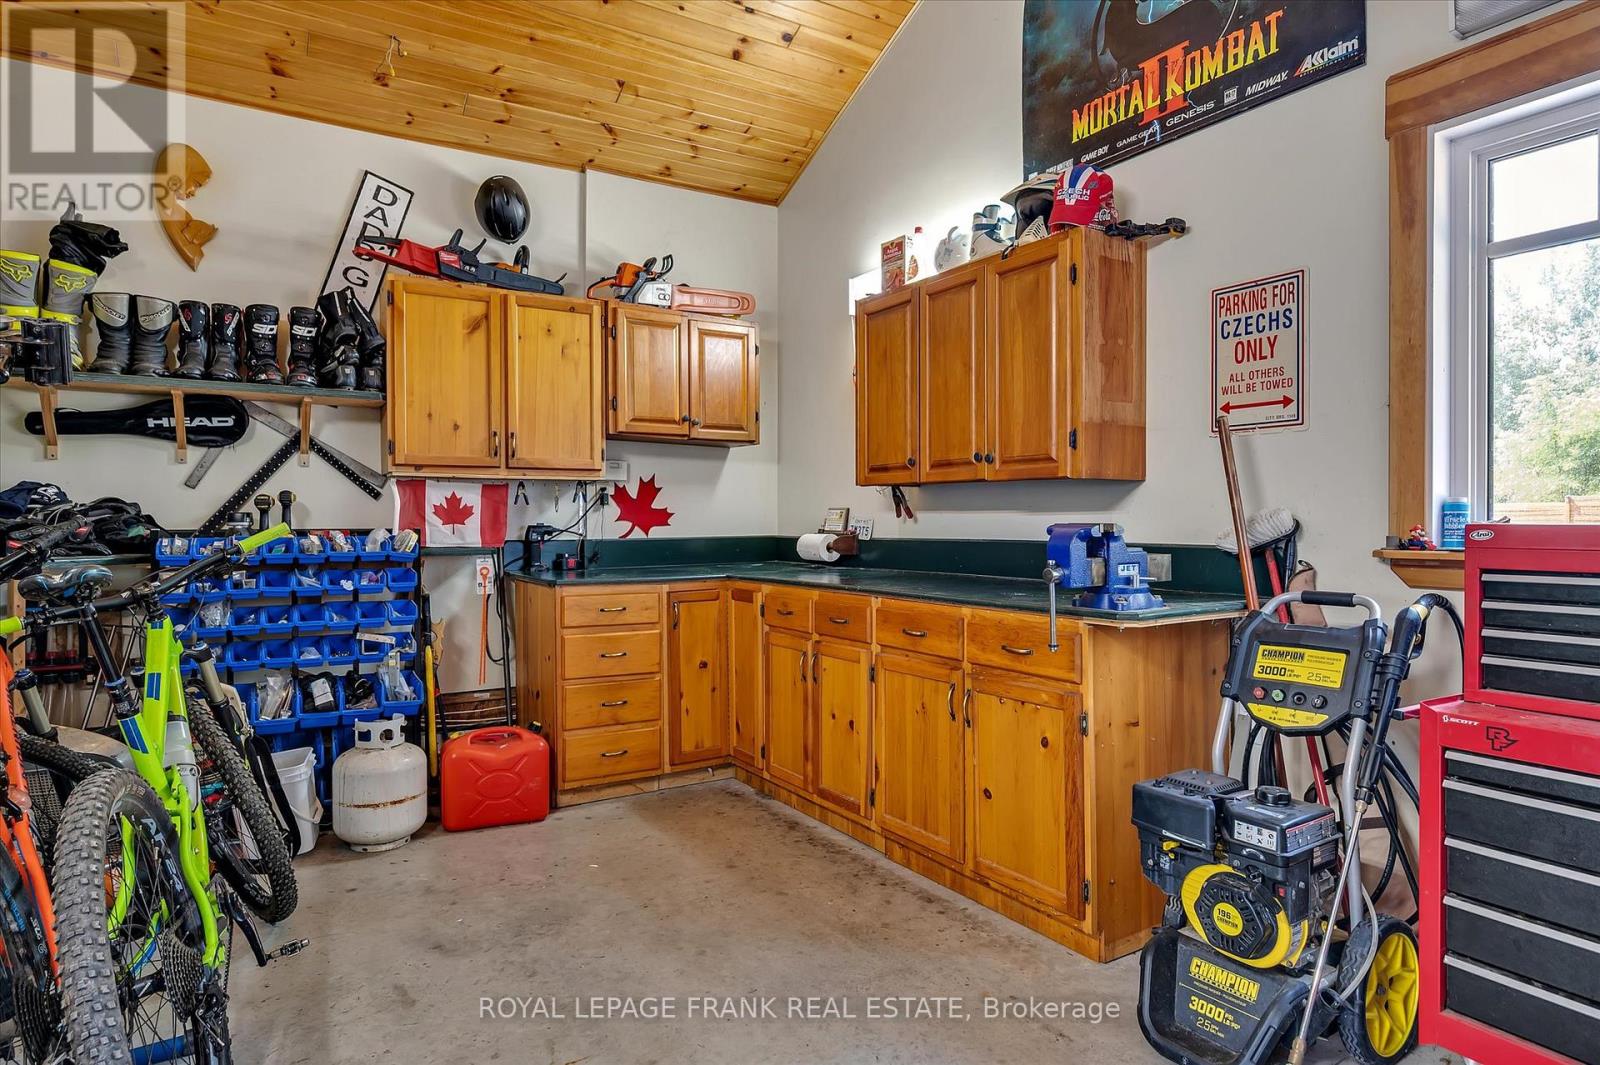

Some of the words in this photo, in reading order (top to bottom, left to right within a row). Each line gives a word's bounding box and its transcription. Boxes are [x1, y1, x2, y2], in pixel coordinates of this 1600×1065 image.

[1072, 68, 1160, 144] MORTAL
[1165, 9, 1284, 101] KOMBAT
[1166, 101, 1215, 127] GENESIS
[1098, 145, 1110, 156] BOY
[1116, 134, 1137, 148] GAME
[1218, 287, 1267, 319] PARKING
[1272, 281, 1296, 307] FOR
[1220, 308, 1293, 340] CZECHS
[1234, 335, 1279, 364] ONLY
[1229, 372, 1245, 383] ALL
[1248, 366, 1285, 381] OTHERS
[1221, 384, 1242, 396] WILL
[1246, 382, 1257, 392] BE
[1260, 377, 1293, 391] TOWED
[146, 417, 235, 428] HEAD
[1262, 648, 1305, 661] CHAMPION
[1258, 665, 1287, 677] 3000
[1190, 957, 1259, 999] CHAMPION
[1189, 995, 1225, 1023] 3000
